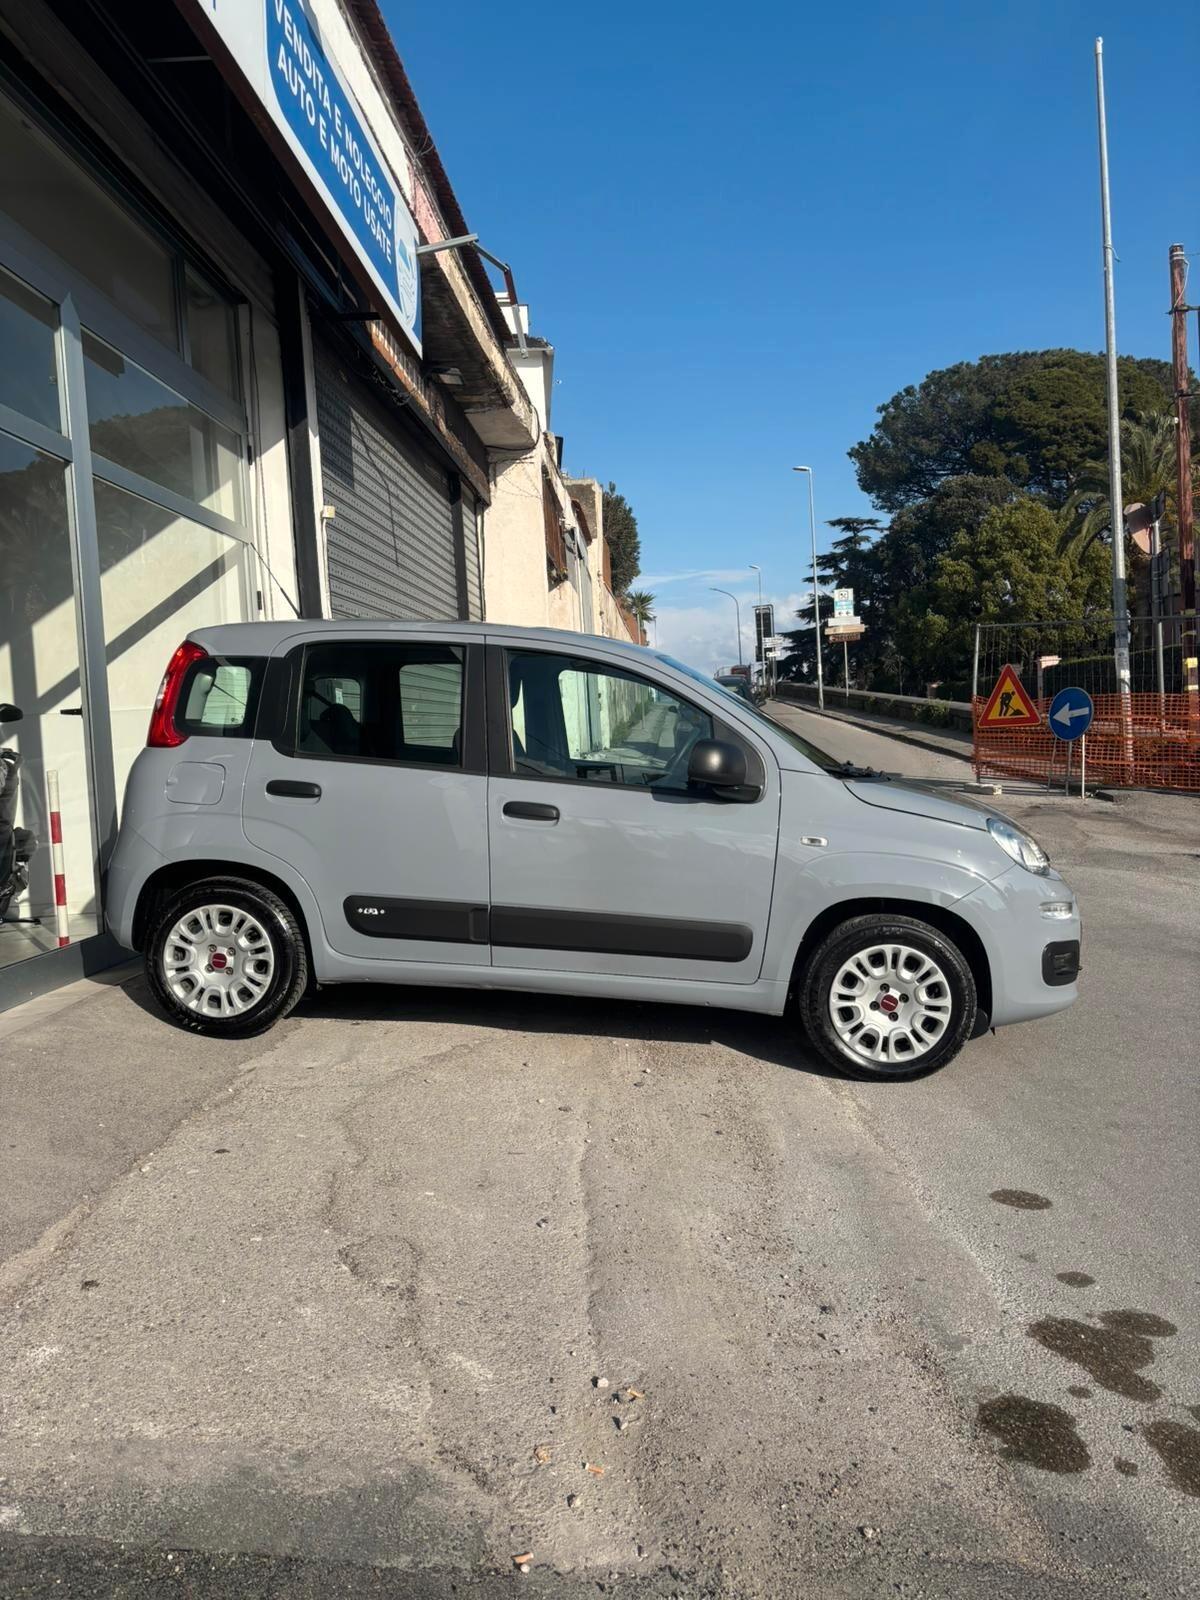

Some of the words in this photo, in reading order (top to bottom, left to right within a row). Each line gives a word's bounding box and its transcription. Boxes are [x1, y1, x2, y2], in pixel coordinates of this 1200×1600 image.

[275, 0, 332, 119] VENDITA
[335, 103, 342, 139] E
[344, 121, 392, 231] NOLEGGIO
[277, 43, 316, 126] AUTO
[319, 112, 328, 151] E
[330, 133, 361, 208] MOTO
[363, 195, 392, 265] USATE
